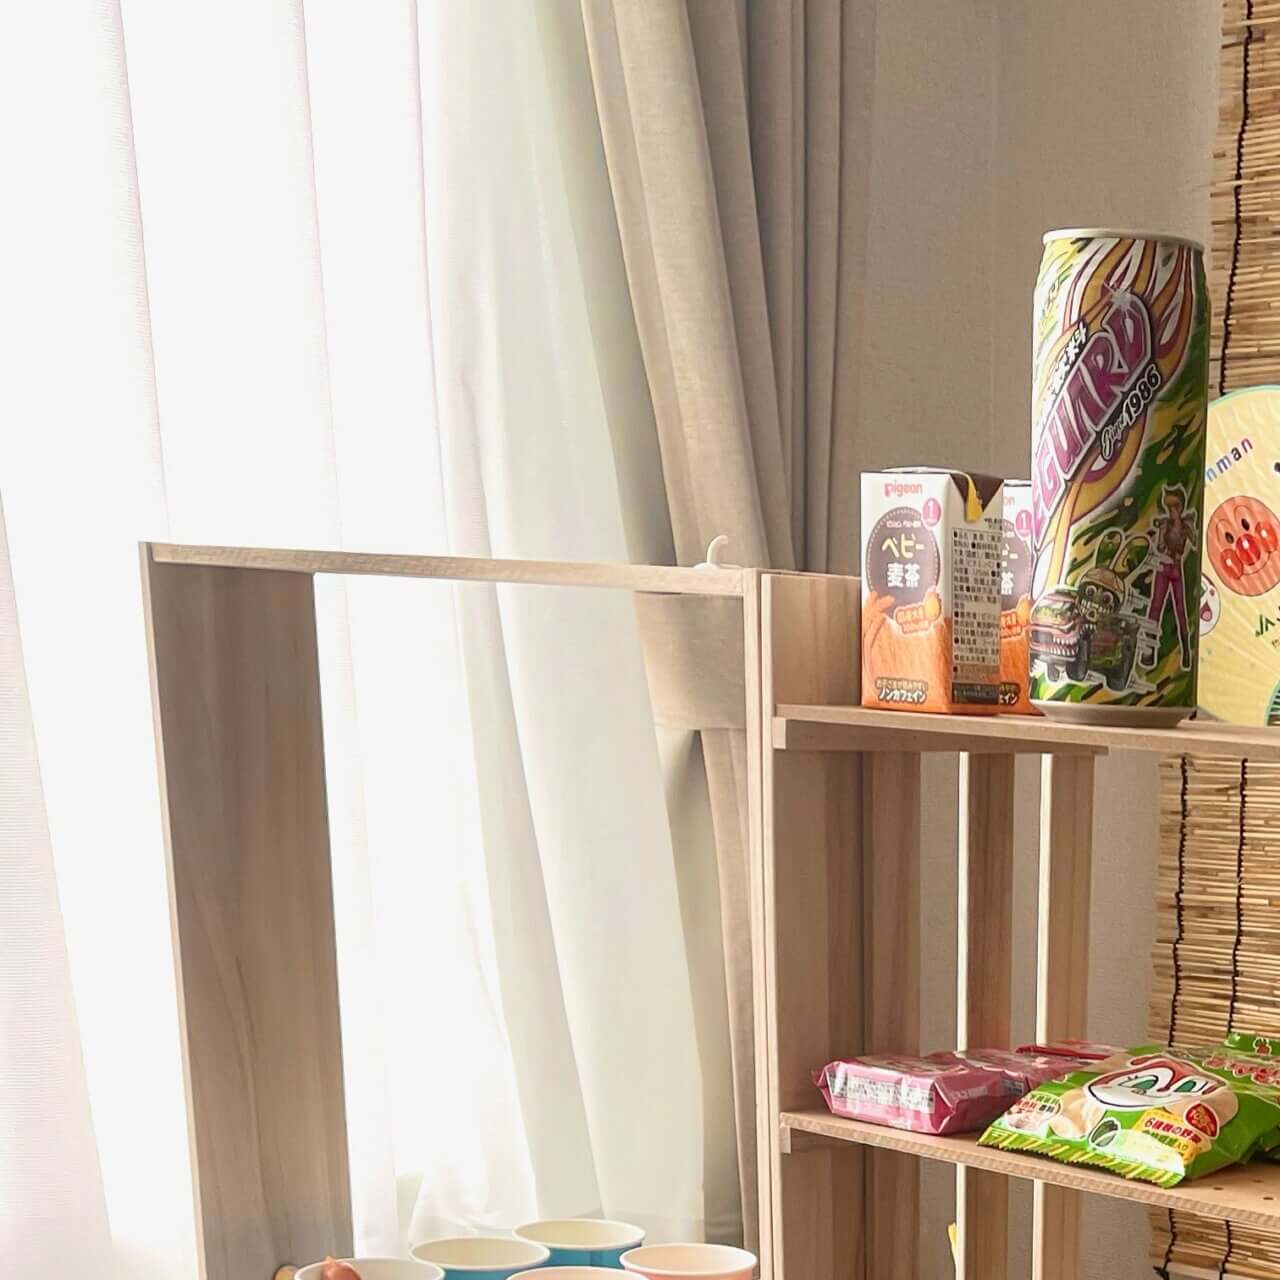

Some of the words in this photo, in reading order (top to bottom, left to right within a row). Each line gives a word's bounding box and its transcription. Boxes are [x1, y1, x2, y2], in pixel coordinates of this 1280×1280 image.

[1123, 363, 1162, 423] 1986
[884, 481, 923, 498] pigeon
[882, 533, 925, 559] ベビー
[887, 562, 921, 588] 麦茶
[879, 687, 926, 704] ノンカフェイン
